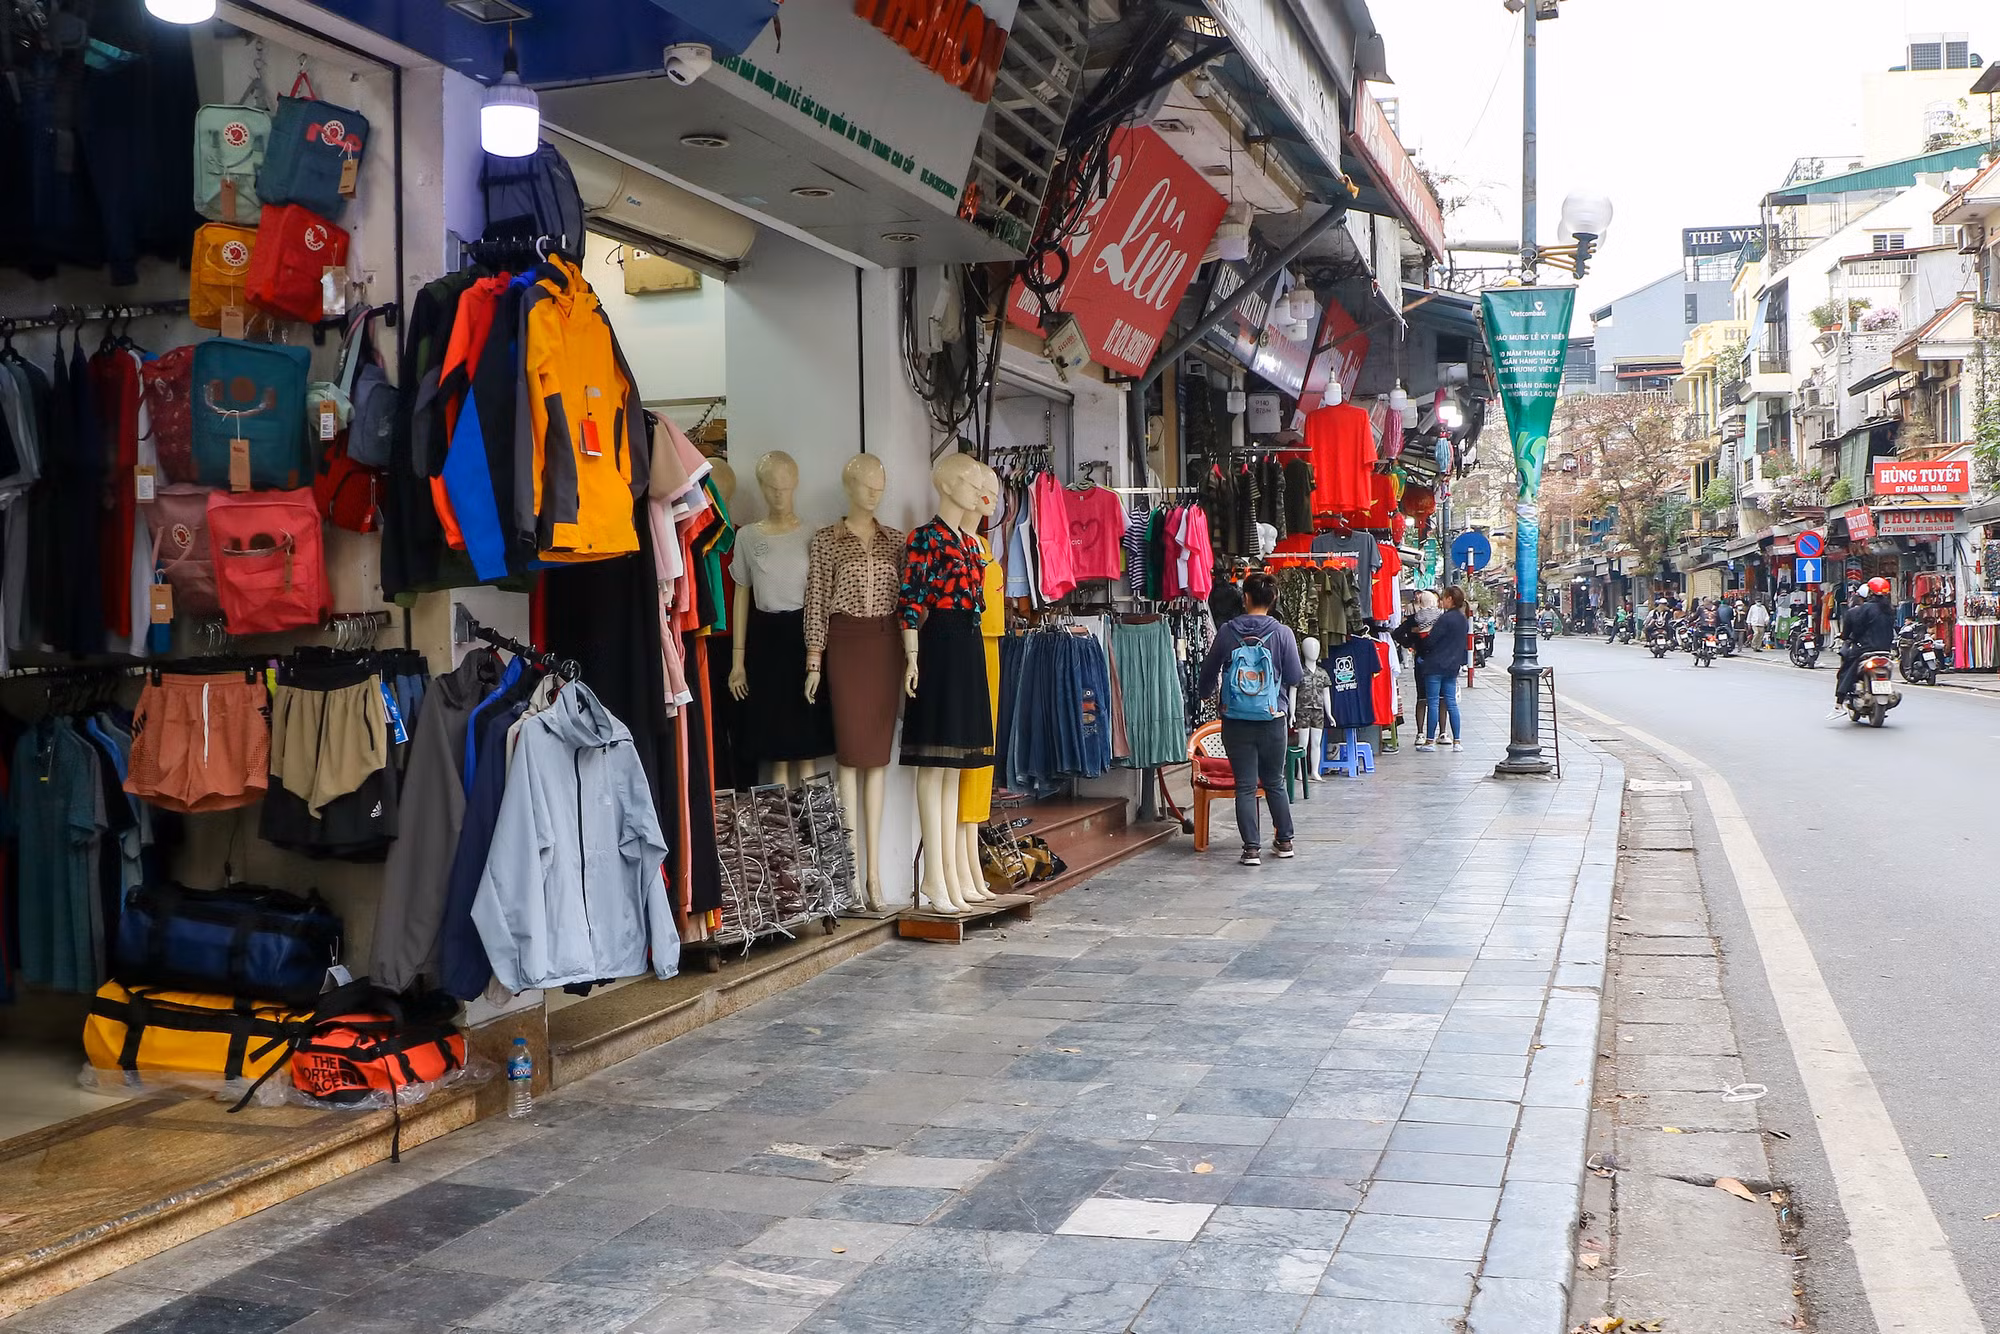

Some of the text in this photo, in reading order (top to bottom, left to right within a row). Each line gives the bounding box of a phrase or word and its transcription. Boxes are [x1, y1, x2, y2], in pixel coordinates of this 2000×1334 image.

[1688, 231, 1723, 245] THE
[1510, 309, 1546, 317] Vietcombank
[1880, 462, 1962, 483] HÙNG TUYẾT
[1907, 484, 1929, 493] HÀNG
[311, 1055, 338, 1069] THE
